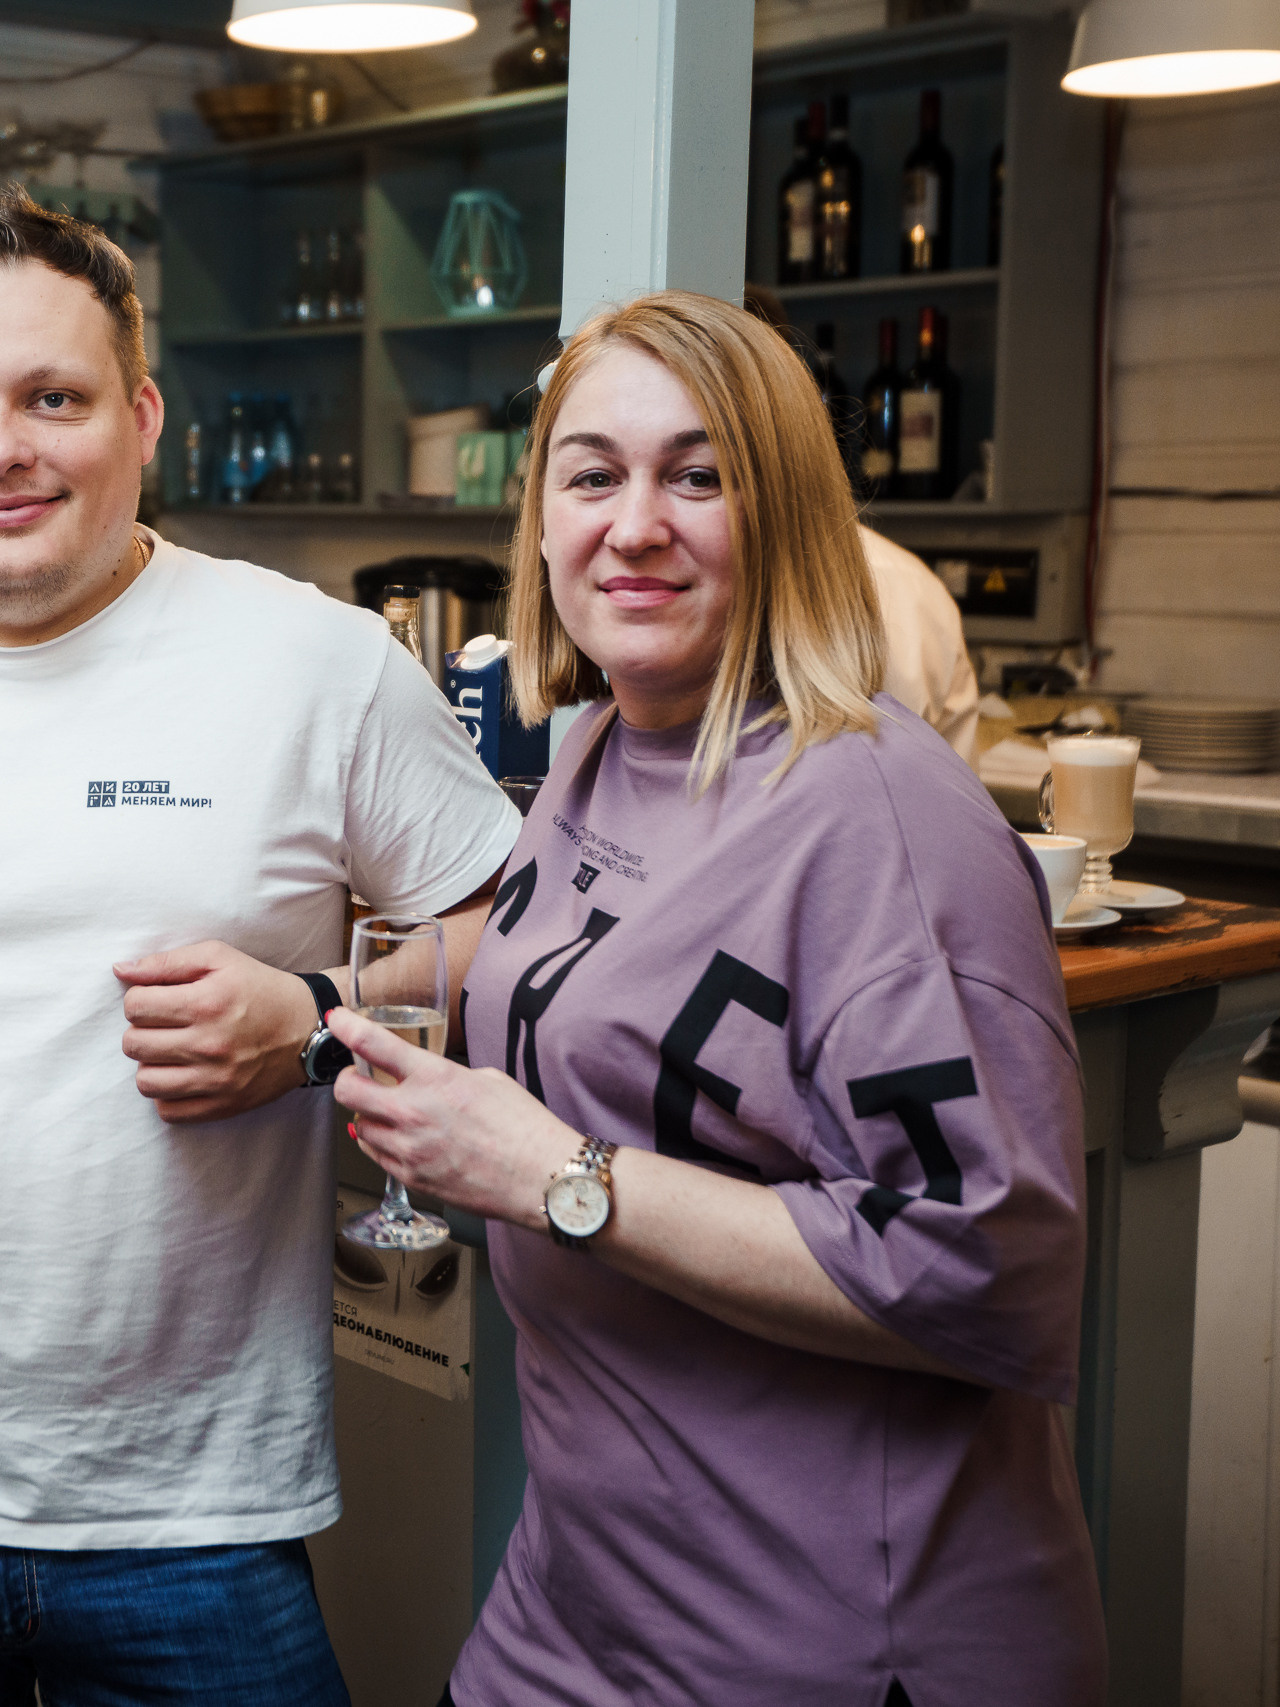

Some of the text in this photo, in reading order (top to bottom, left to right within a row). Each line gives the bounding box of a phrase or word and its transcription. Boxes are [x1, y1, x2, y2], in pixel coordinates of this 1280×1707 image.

[123, 782, 169, 793] 20 ЛЕТ
[121, 796, 212, 808] МЕНЯЕМ МИР!
[333, 1299, 358, 1317] ЕТСЯ
[333, 1312, 450, 1368] ДЕОНАБЛЮДЕНИЕ
